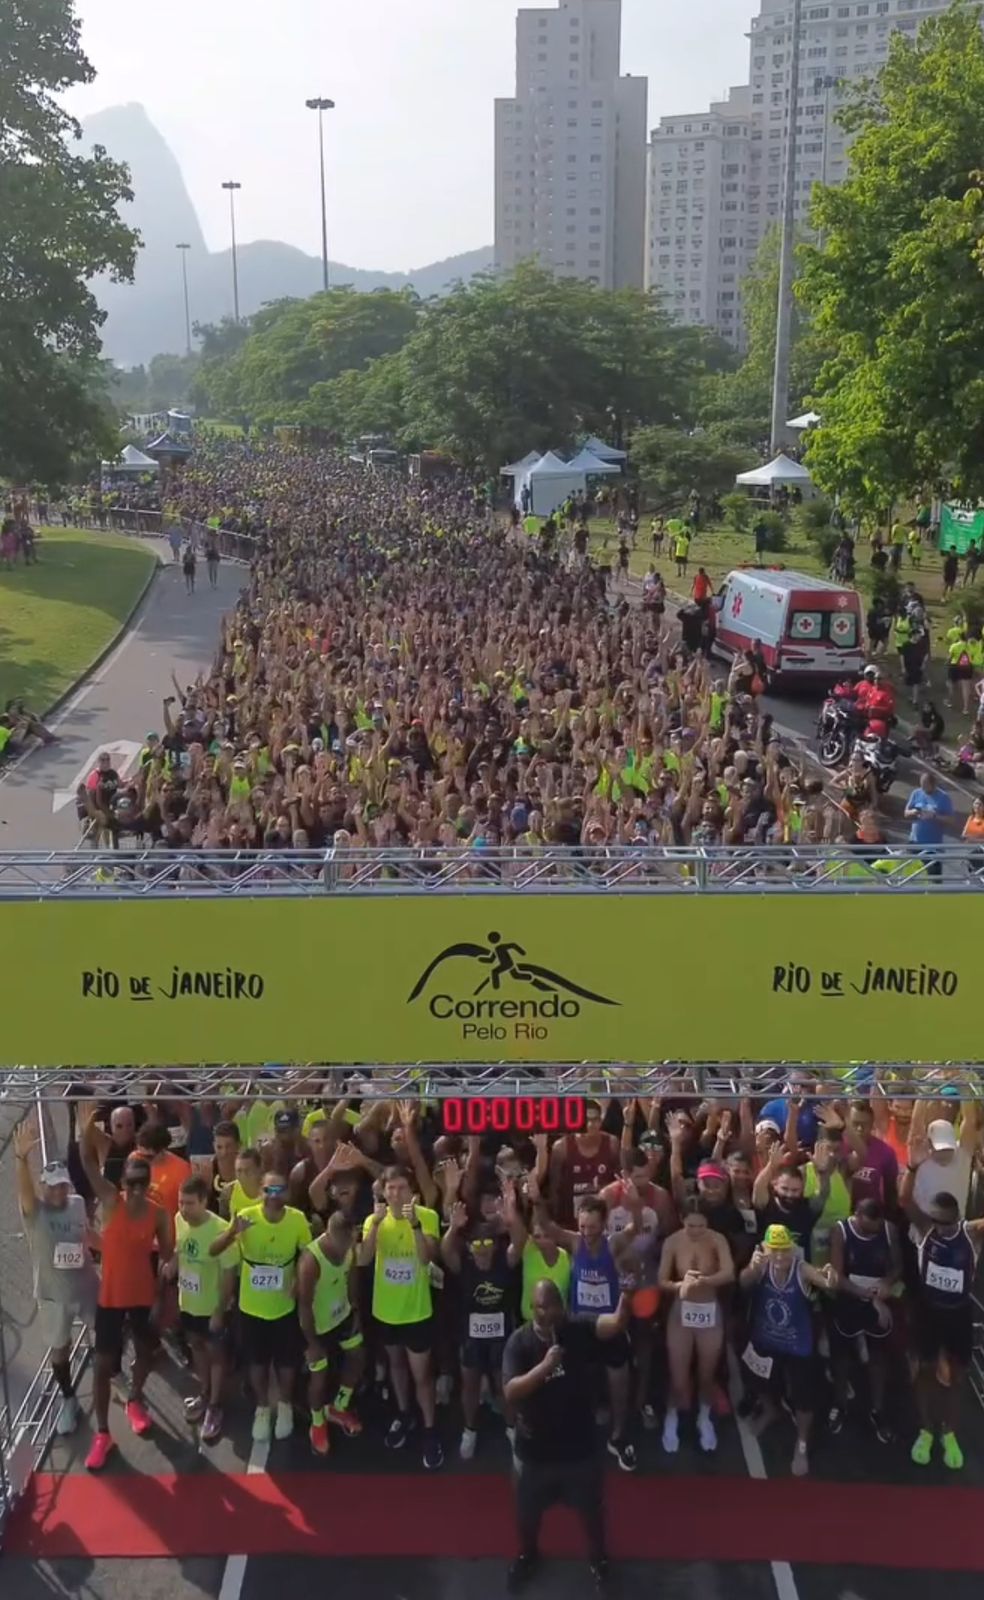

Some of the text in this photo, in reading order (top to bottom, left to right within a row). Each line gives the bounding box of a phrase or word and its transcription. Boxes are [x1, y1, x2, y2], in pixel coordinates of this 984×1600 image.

[130, 976, 153, 999] DE
[821, 972, 844, 995] DE
[429, 994, 580, 1019] Correndo
[463, 1023, 548, 1040] Pelo Rio
[443, 1096, 585, 1133] 00:00:00
[57, 1253, 81, 1263] 1102
[251, 1275, 279, 1286] 6271
[930, 1272, 959, 1289] 5197
[684, 1312, 711, 1323] 4791
[472, 1322, 501, 1333] 3059
